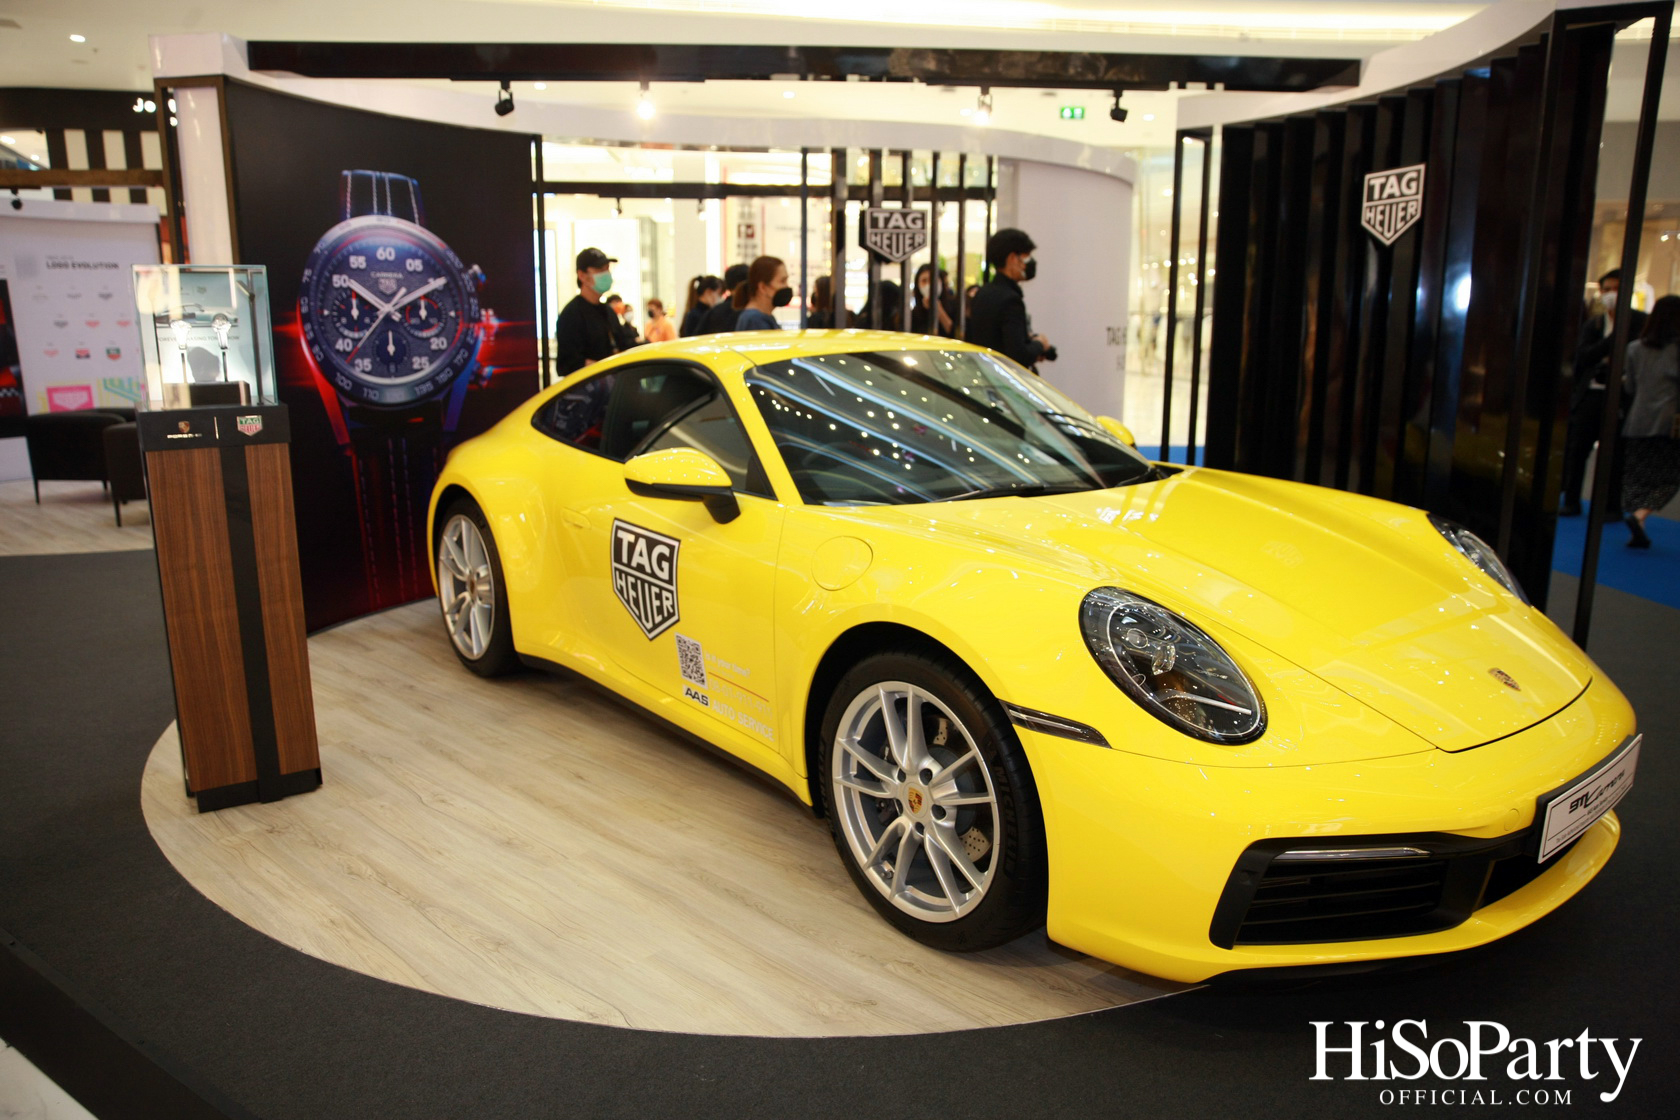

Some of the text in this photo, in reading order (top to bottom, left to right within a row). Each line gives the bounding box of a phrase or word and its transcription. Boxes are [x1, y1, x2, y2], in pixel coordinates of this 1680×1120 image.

[1369, 171, 1418, 200] TAG
[872, 212, 923, 229] TAG
[1366, 201, 1418, 237] HEUER
[871, 232, 924, 258] HEUER
[376, 247, 395, 261] 60
[46, 261, 119, 269] LOGO EVOLUTION
[349, 255, 367, 269] 55
[405, 258, 424, 272] 05
[332, 274, 349, 288] 50
[335, 338, 353, 352] 40
[430, 337, 448, 350] 20
[354, 358, 372, 372] 35
[412, 356, 430, 369] 25
[617, 529, 670, 580] TAG
[615, 570, 674, 630] HEUER
[685, 687, 709, 706] AAS
[711, 699, 775, 742] AUTO SERVICE
